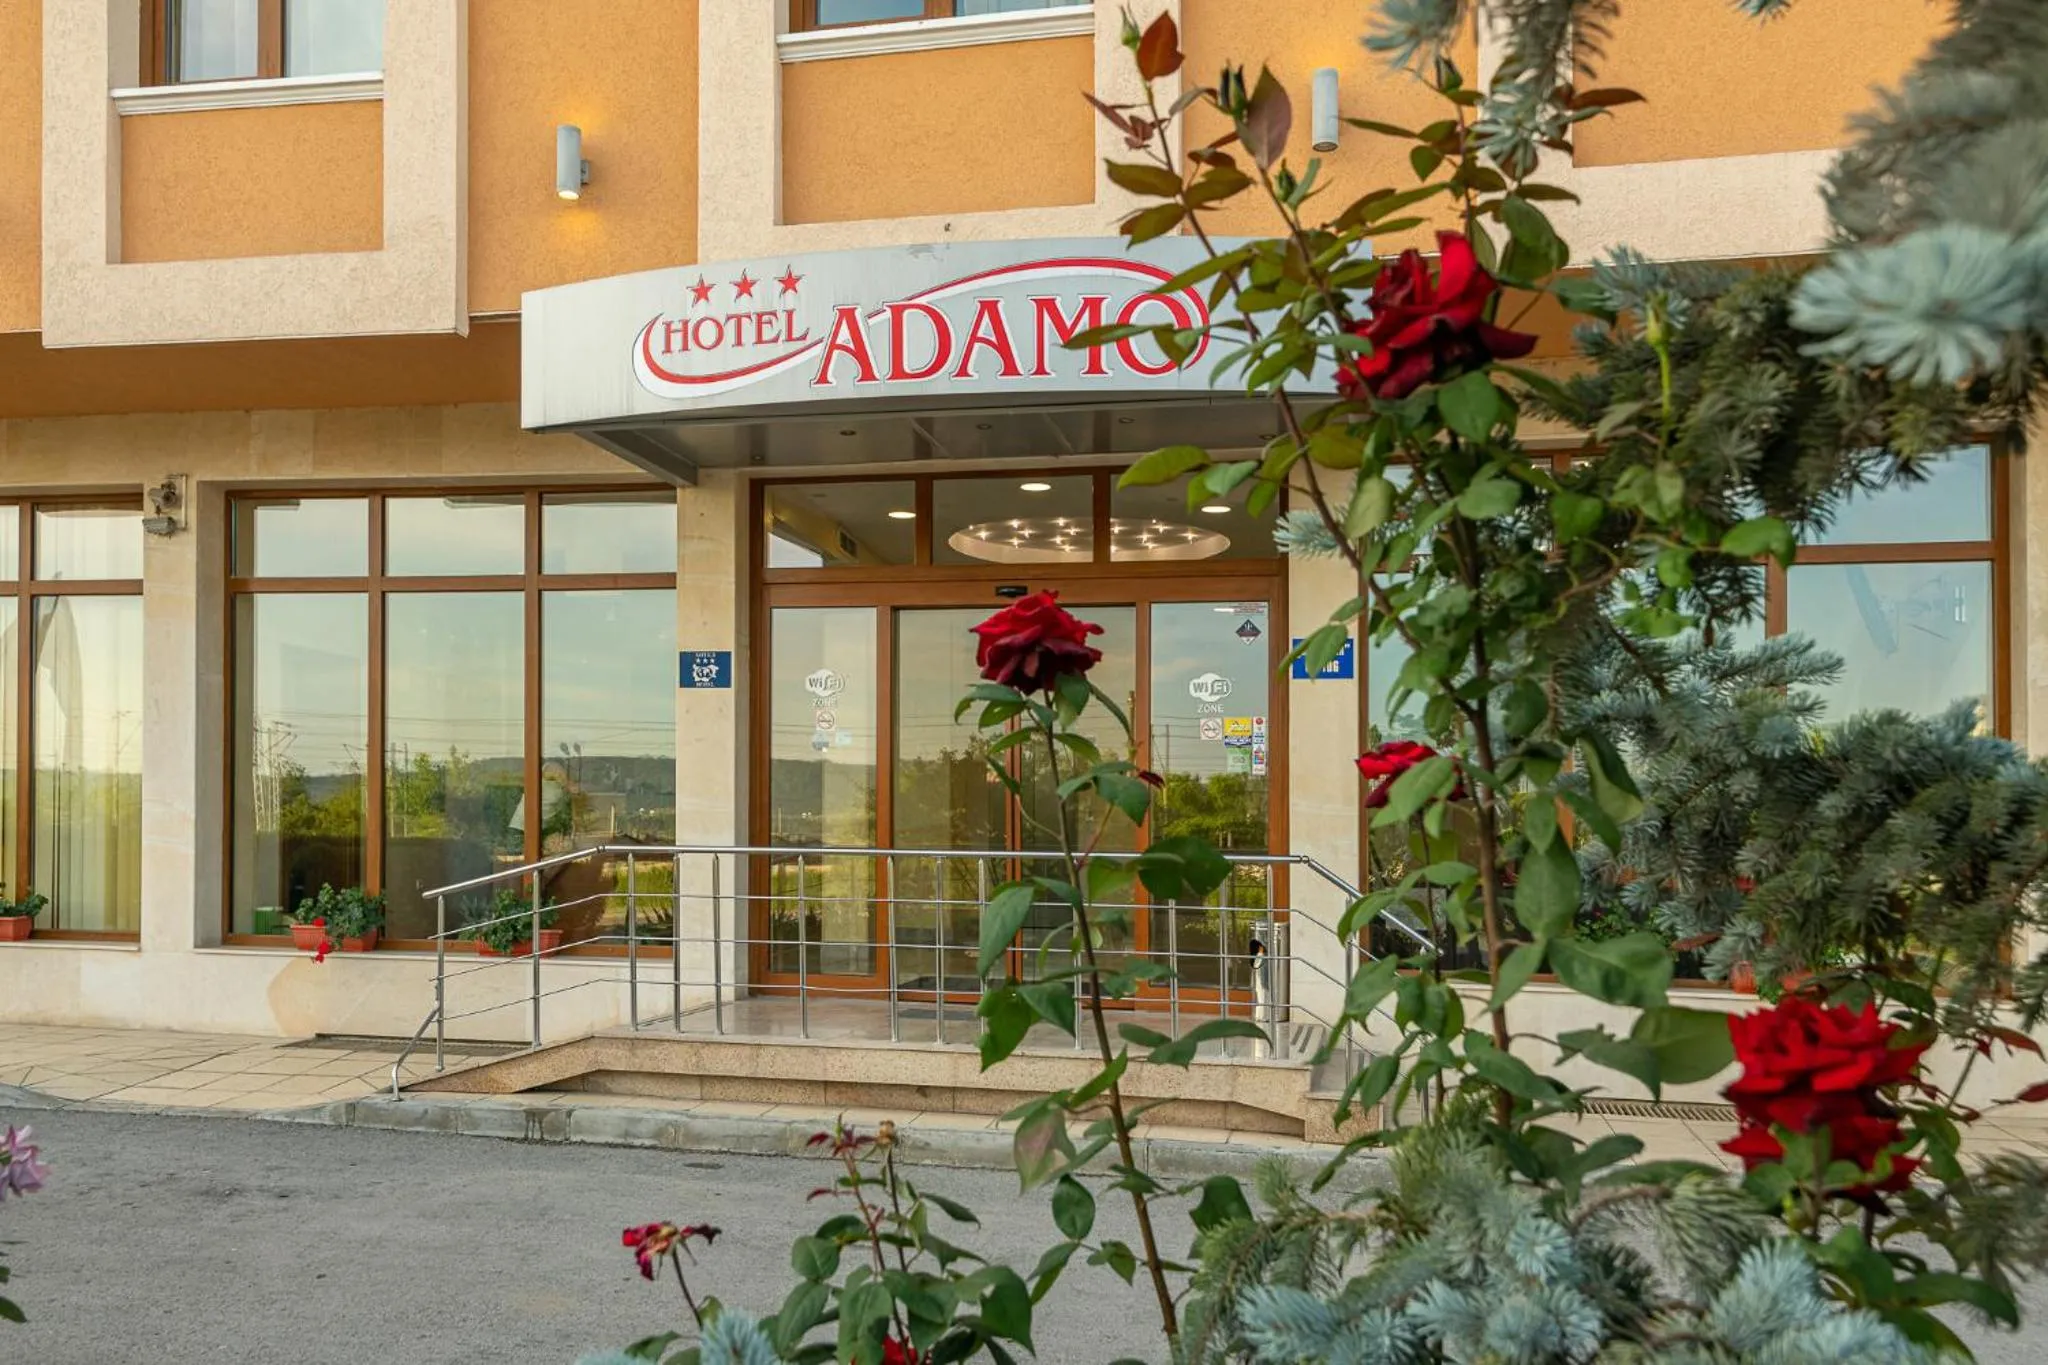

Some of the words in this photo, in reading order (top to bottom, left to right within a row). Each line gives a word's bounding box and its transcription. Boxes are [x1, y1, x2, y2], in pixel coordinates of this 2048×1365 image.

[661, 308, 810, 355] HOTEL
[812, 293, 1194, 386] ADAMO
[1197, 703, 1224, 713] ZONE
